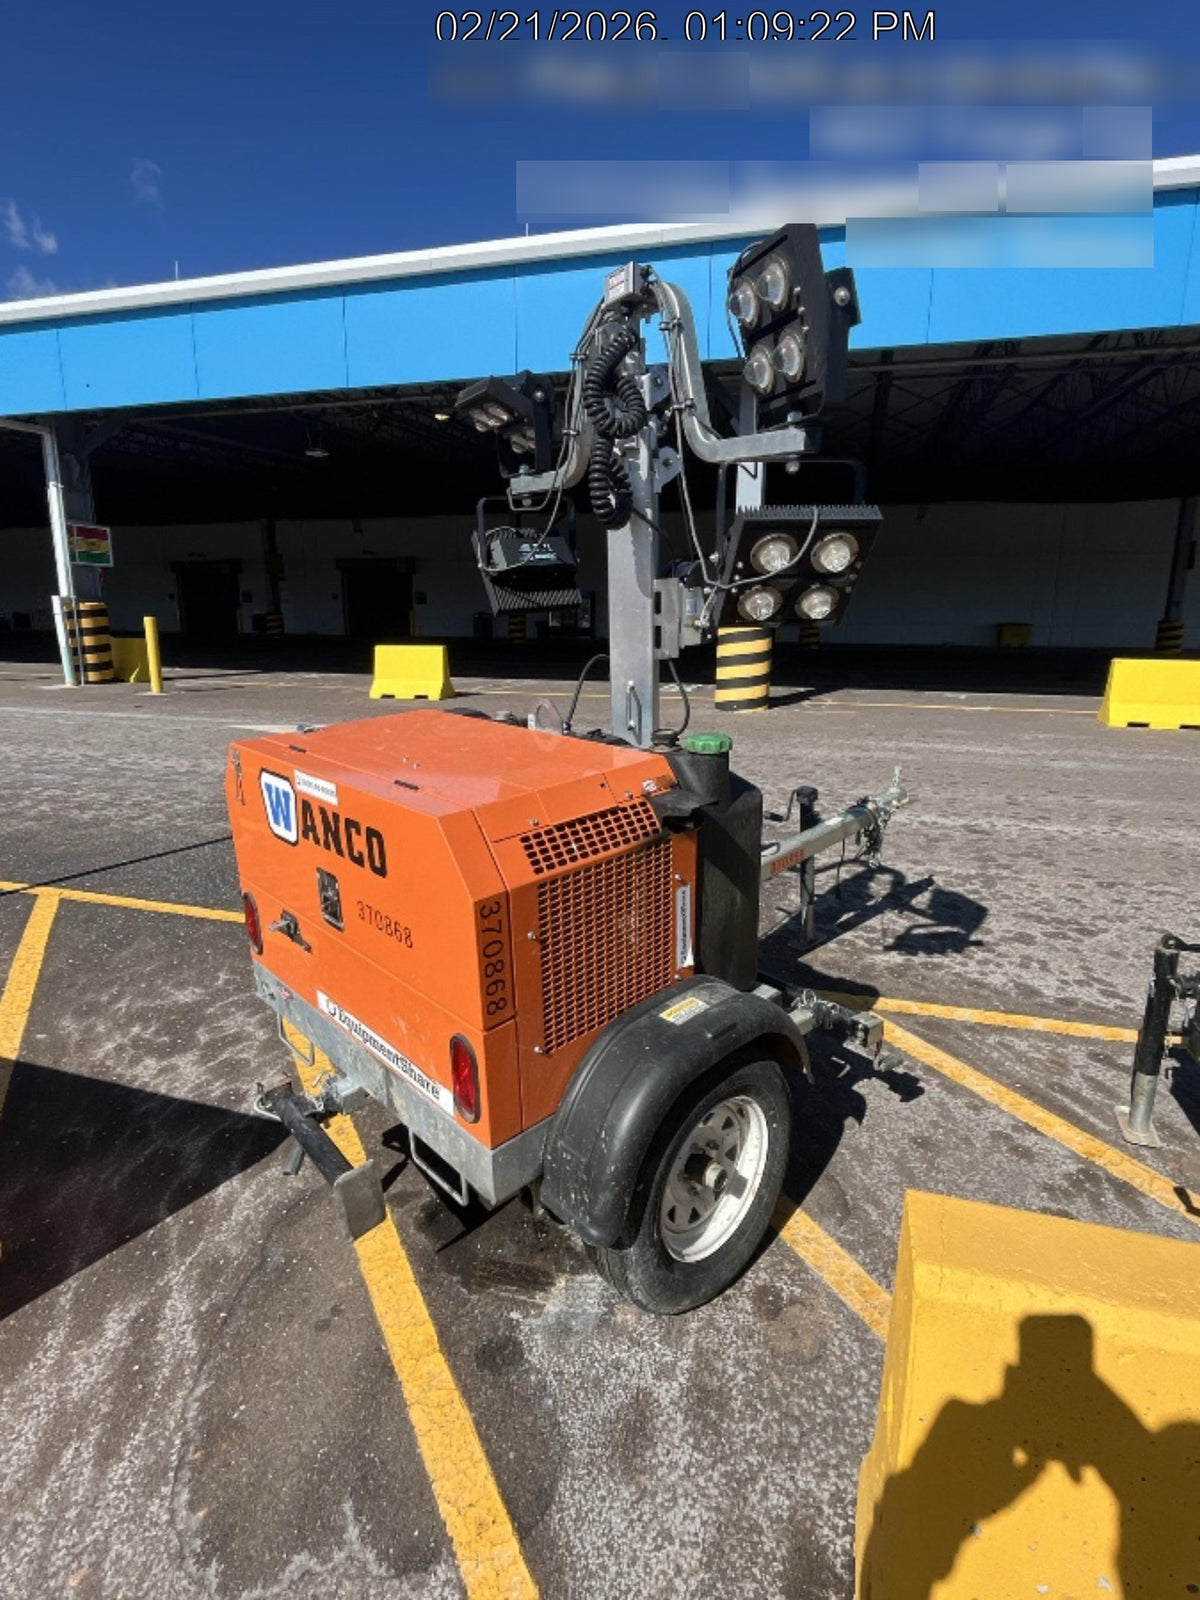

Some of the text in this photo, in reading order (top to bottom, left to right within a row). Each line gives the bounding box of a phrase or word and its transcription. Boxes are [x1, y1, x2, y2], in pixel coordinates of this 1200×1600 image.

[261, 776, 388, 879] WANCO
[356, 900, 414, 949] 370868
[479, 900, 508, 1017] 370868
[339, 1007, 440, 1100] EquipmentShare
